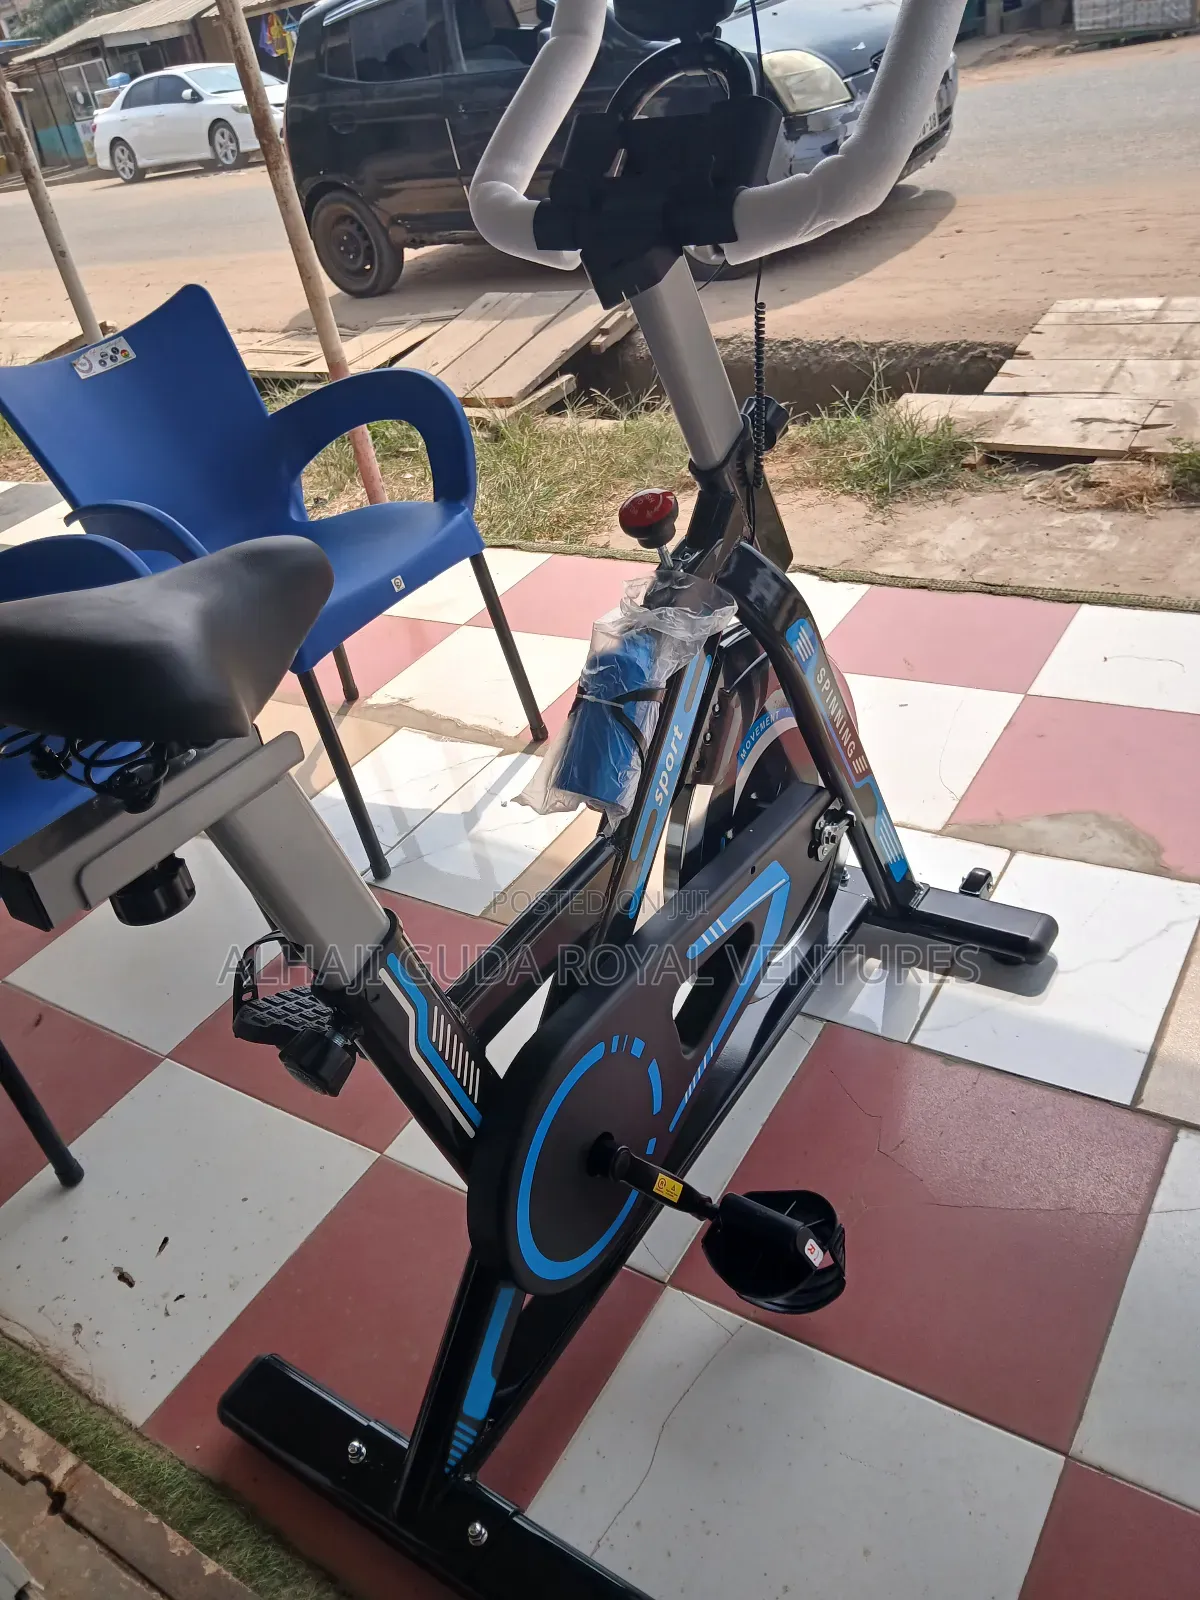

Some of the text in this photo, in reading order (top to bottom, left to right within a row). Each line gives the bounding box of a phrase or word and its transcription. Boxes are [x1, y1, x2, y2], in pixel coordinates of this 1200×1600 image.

[740, 710, 780, 760] MOVEMENT
[816, 667, 856, 759] SPINNING
[655, 724, 683, 807] sport
[807, 1243, 816, 1255] R
